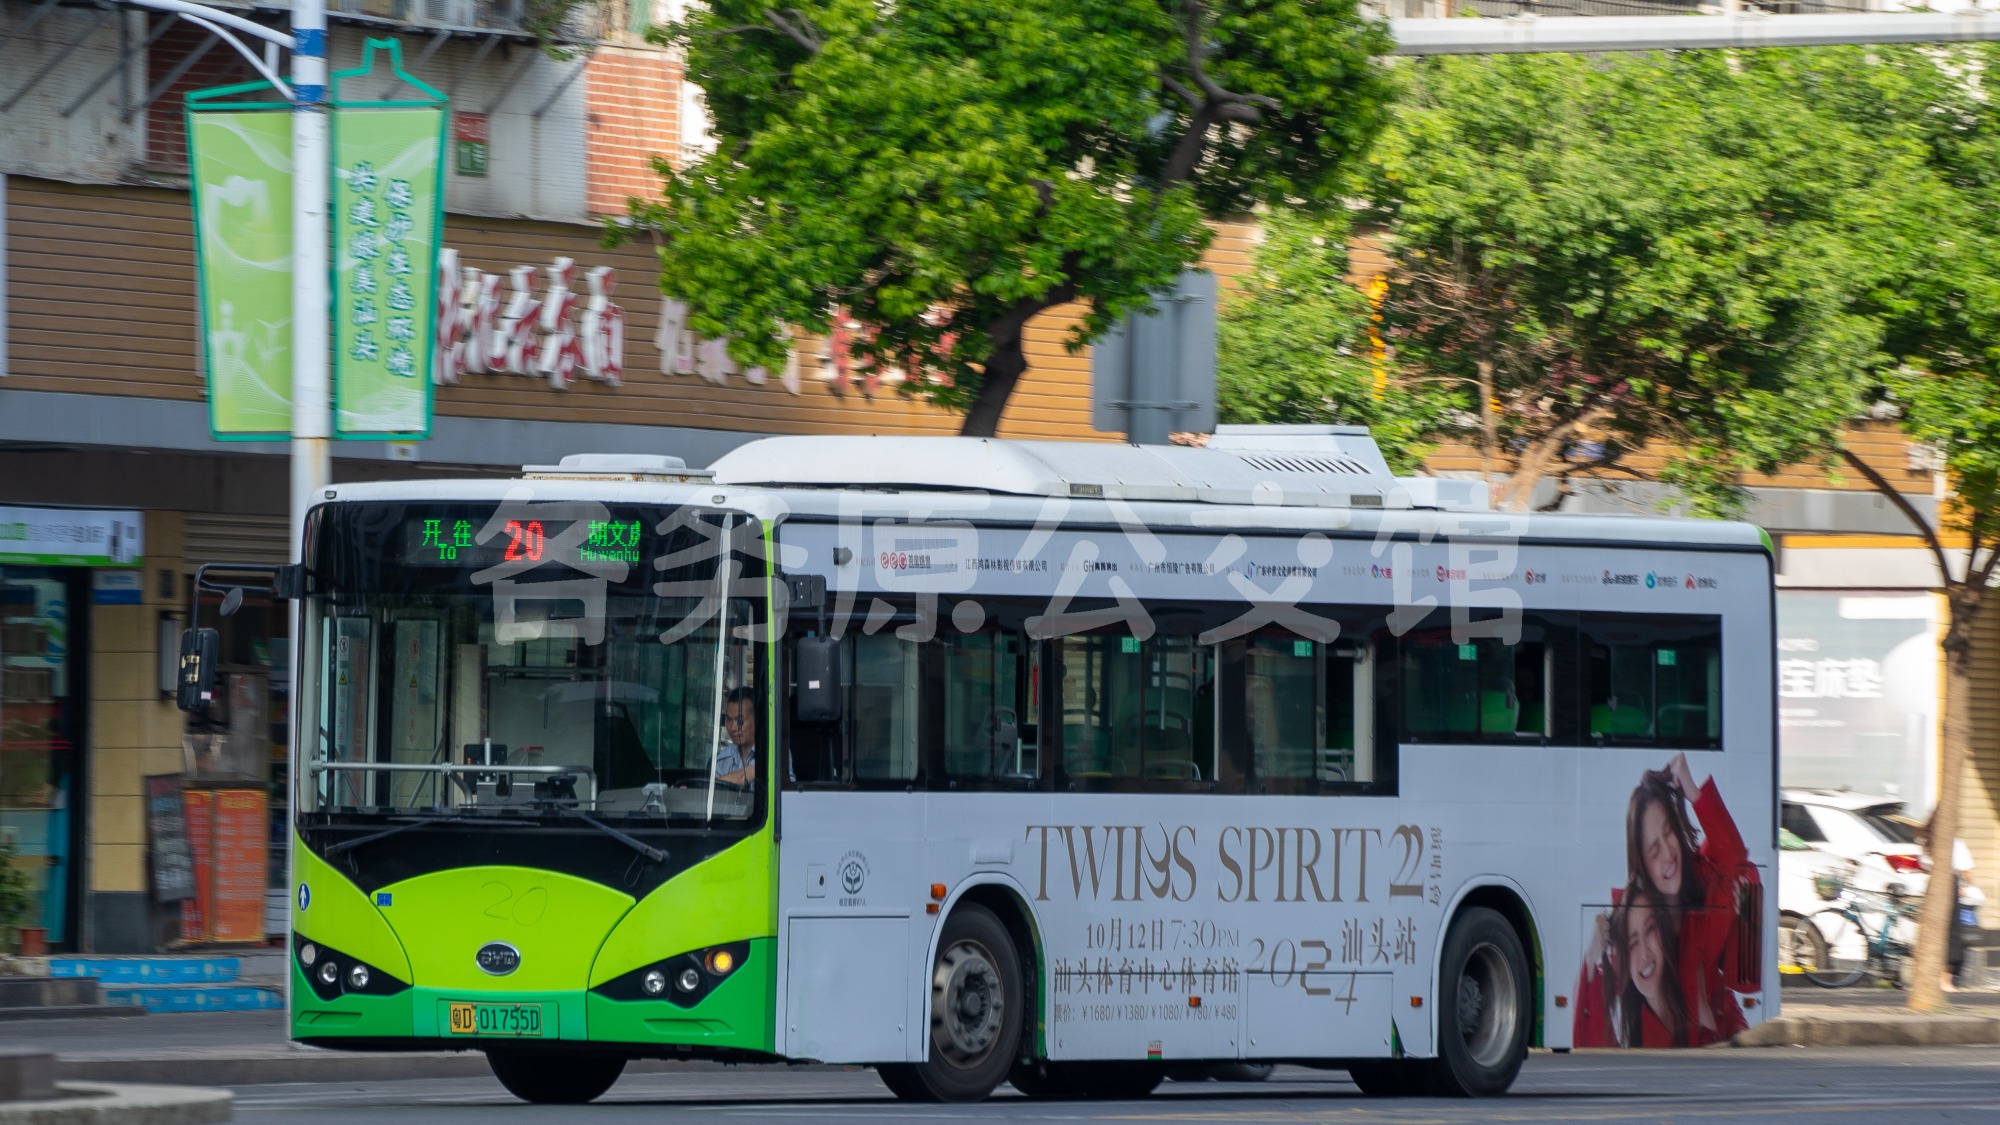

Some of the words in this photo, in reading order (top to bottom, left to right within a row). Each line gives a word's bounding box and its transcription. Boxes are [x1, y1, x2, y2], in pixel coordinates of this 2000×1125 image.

[421, 519, 473, 547] 开往
[438, 543, 457, 560] To
[504, 520, 544, 561] 20
[1218, 825, 1383, 903] SPIRIT
[481, 880, 548, 927] 20
[480, 951, 516, 966] BYD
[1341, 916, 1418, 967] 汕头站
[1054, 956, 1240, 995] 汕头体育中心体育馆
